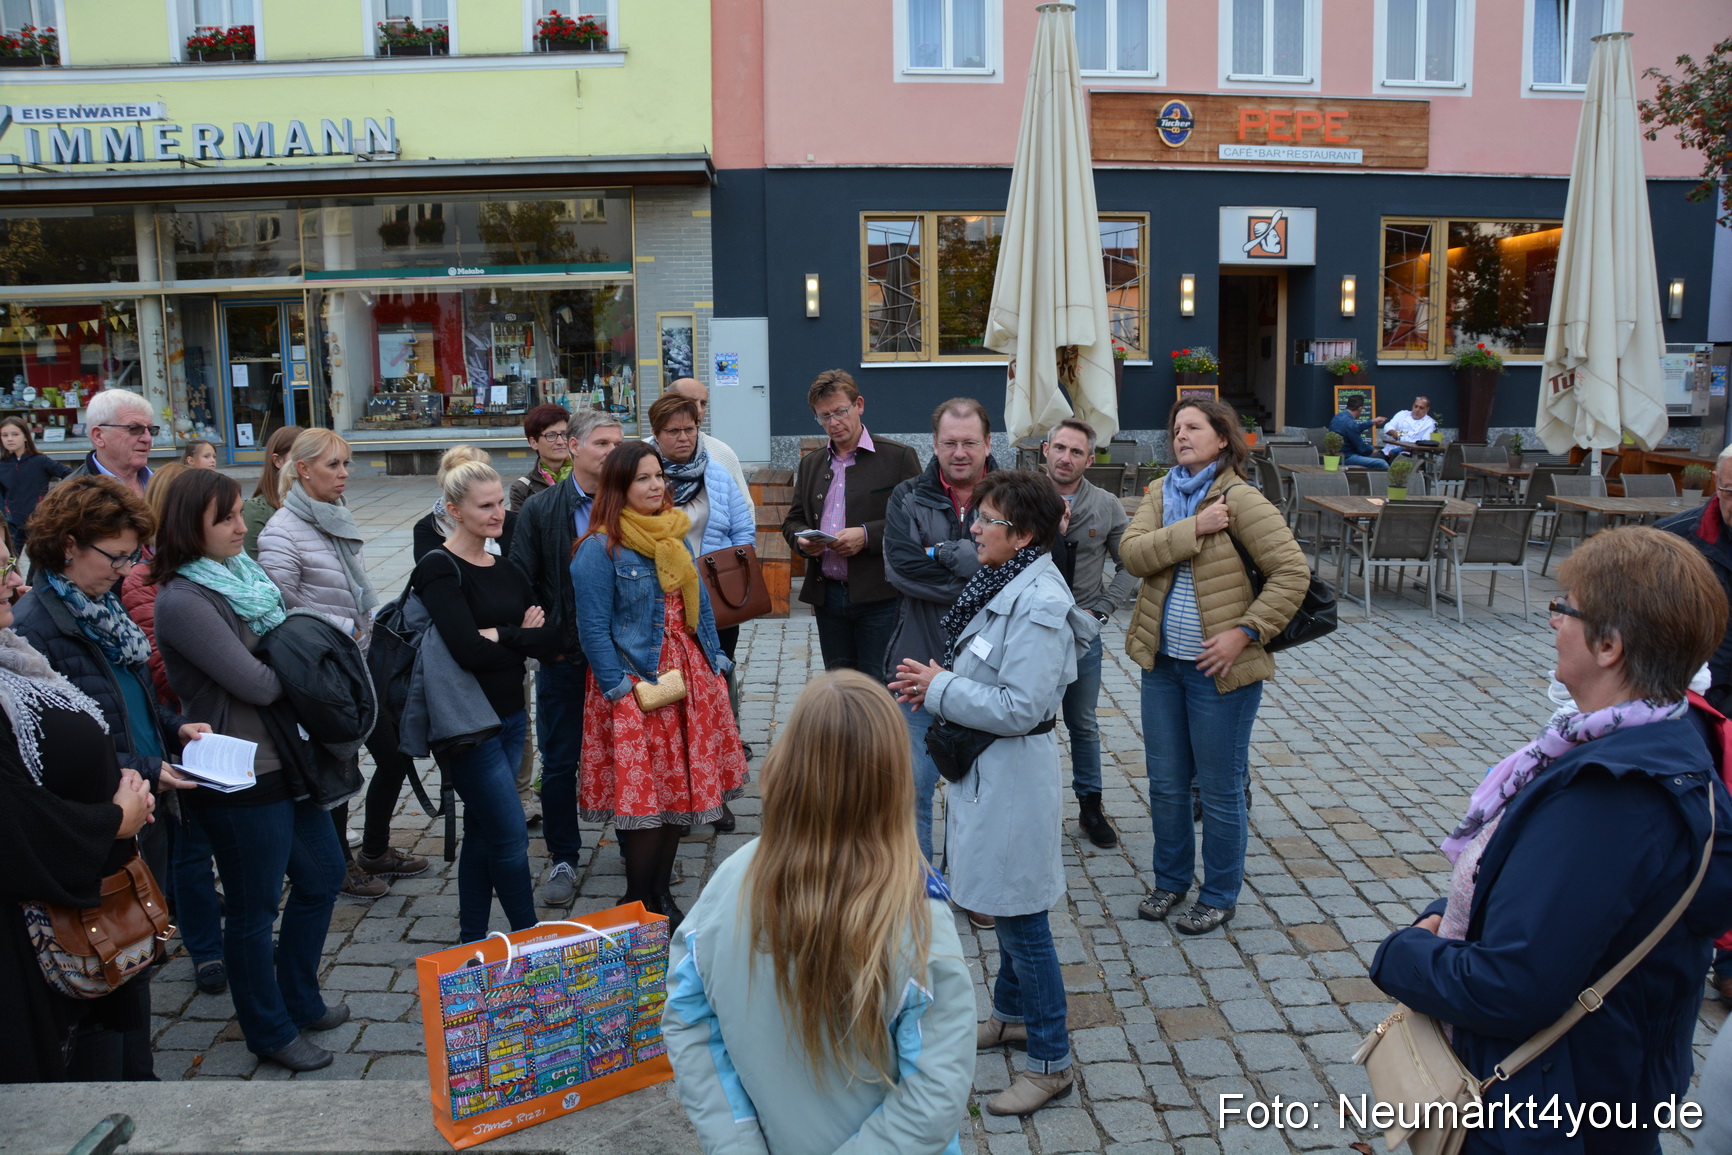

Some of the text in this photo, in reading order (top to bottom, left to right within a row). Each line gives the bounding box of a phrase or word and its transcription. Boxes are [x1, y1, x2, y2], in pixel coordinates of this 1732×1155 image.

[22, 106, 151, 119] EISENWAREN
[1161, 119, 1191, 128] Tucher
[1239, 108, 1349, 142] PEPE
